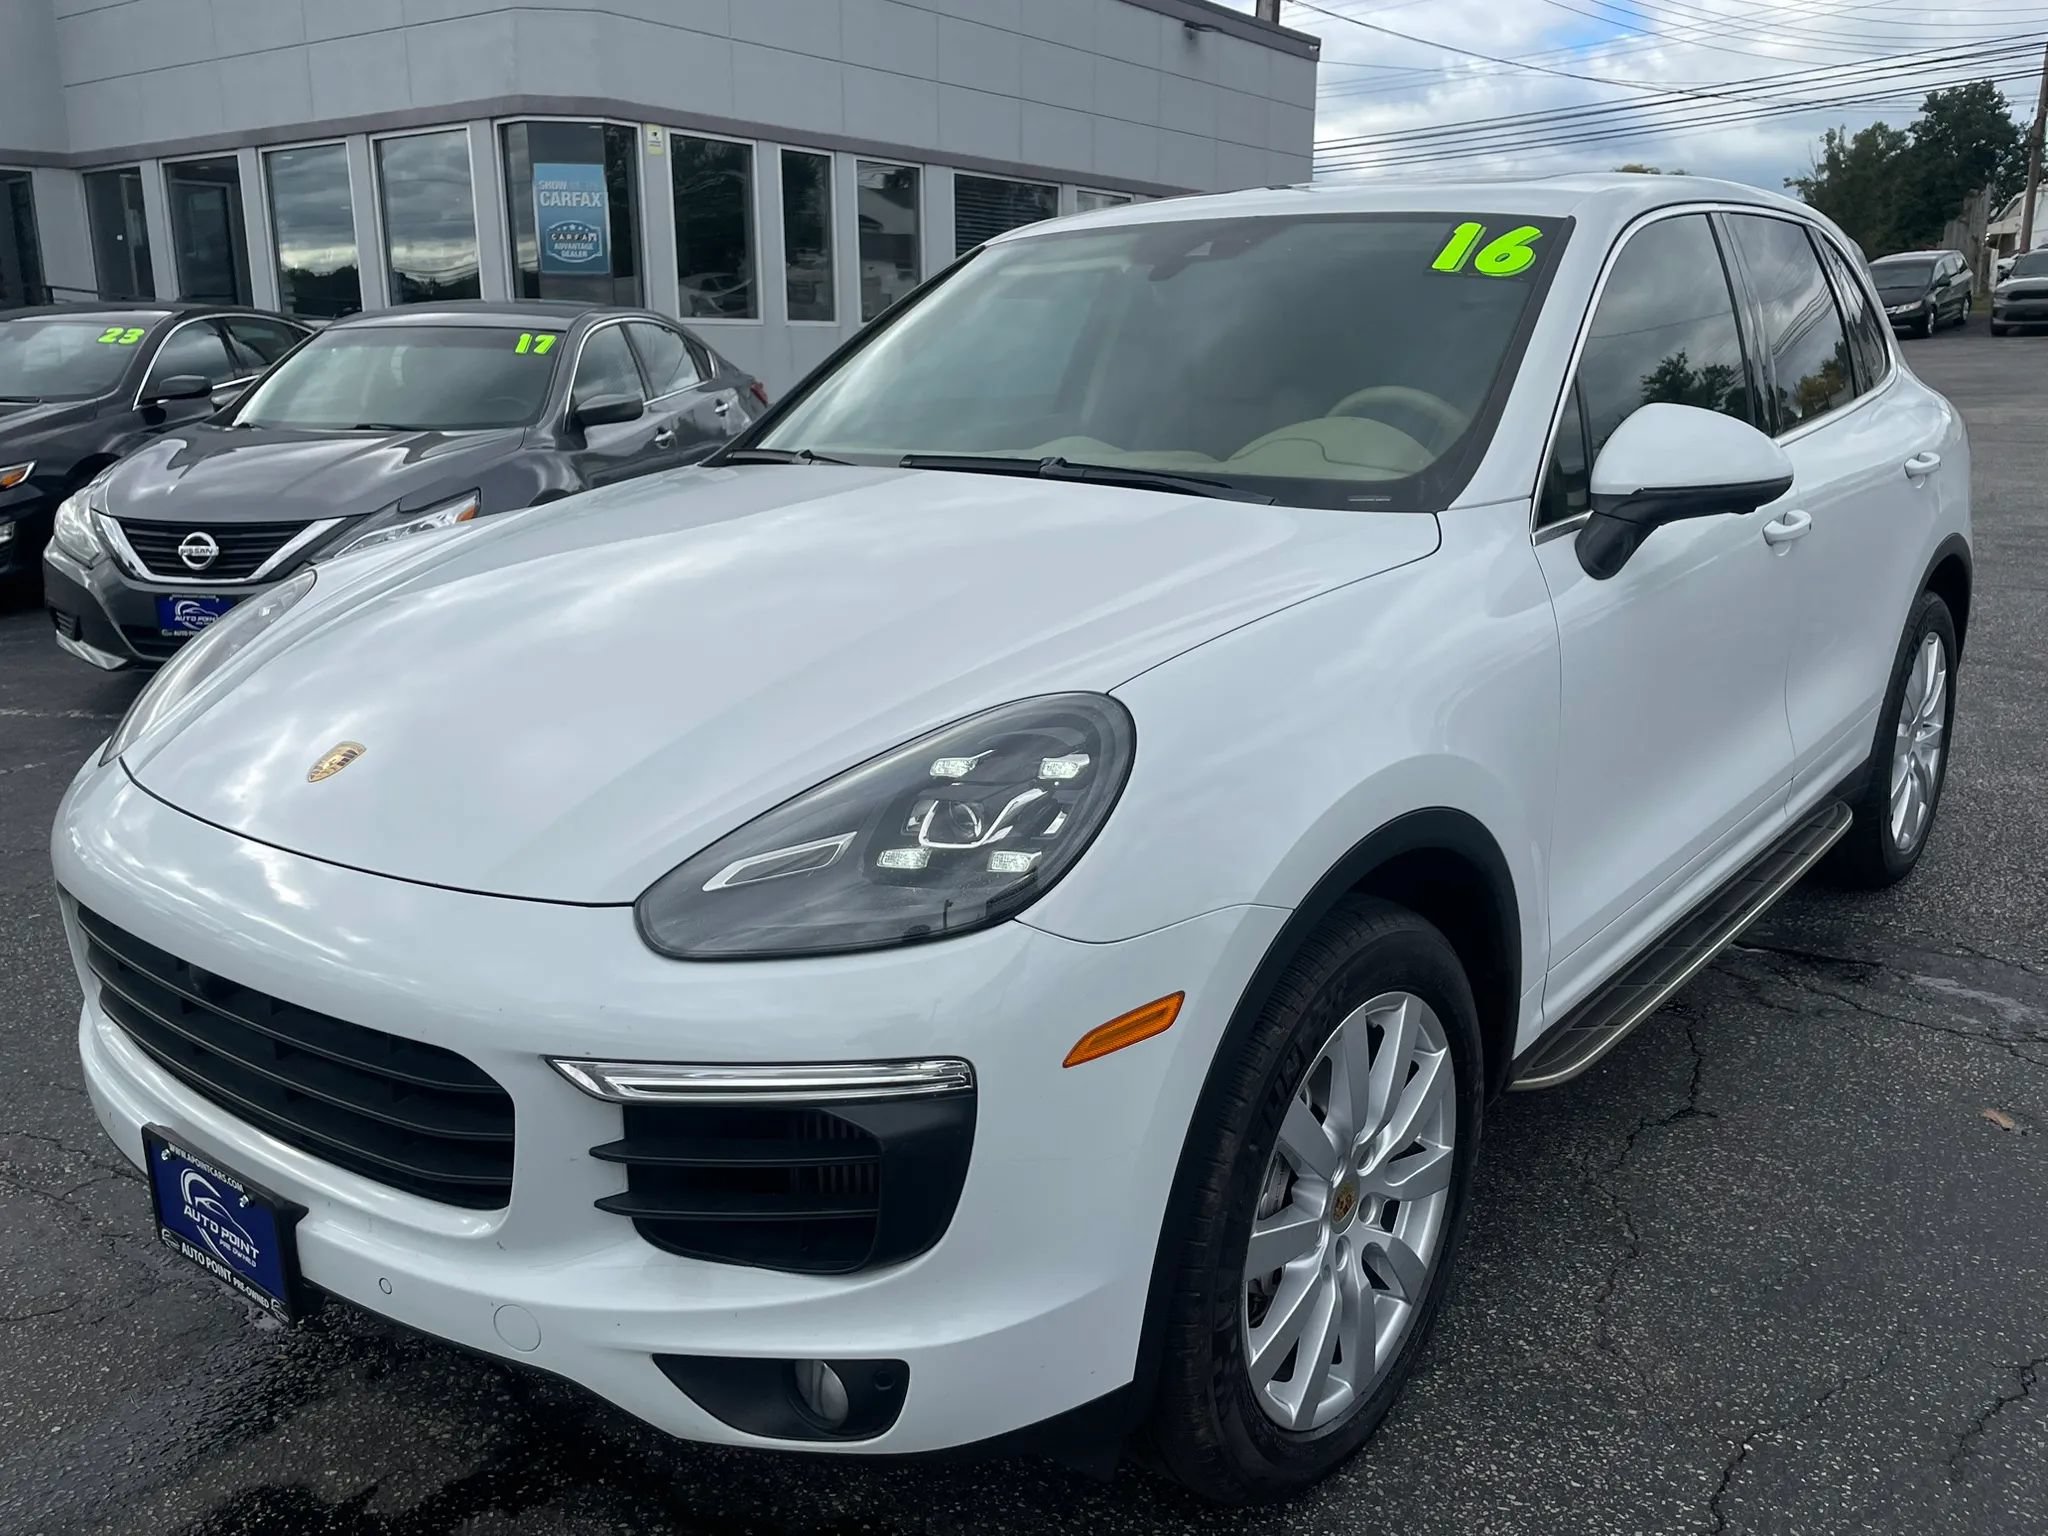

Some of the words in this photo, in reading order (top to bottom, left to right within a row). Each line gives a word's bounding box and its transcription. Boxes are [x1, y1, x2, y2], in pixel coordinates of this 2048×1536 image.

[540, 191, 602, 207] CARFAX
[561, 250, 588, 258] DEALER
[1431, 222, 1543, 277] 16
[97, 327, 145, 345] 23
[515, 332, 557, 355] 17
[180, 547, 214, 555] NISSAN
[168, 1142, 245, 1194] WWW.APOINTCARS.COM
[184, 1204, 219, 1234] AUTO
[221, 1226, 260, 1259] POINT
[181, 1242, 205, 1265] AUTO
[206, 1256, 232, 1282] POINT
[233, 1277, 270, 1309] PRE-OWNED
